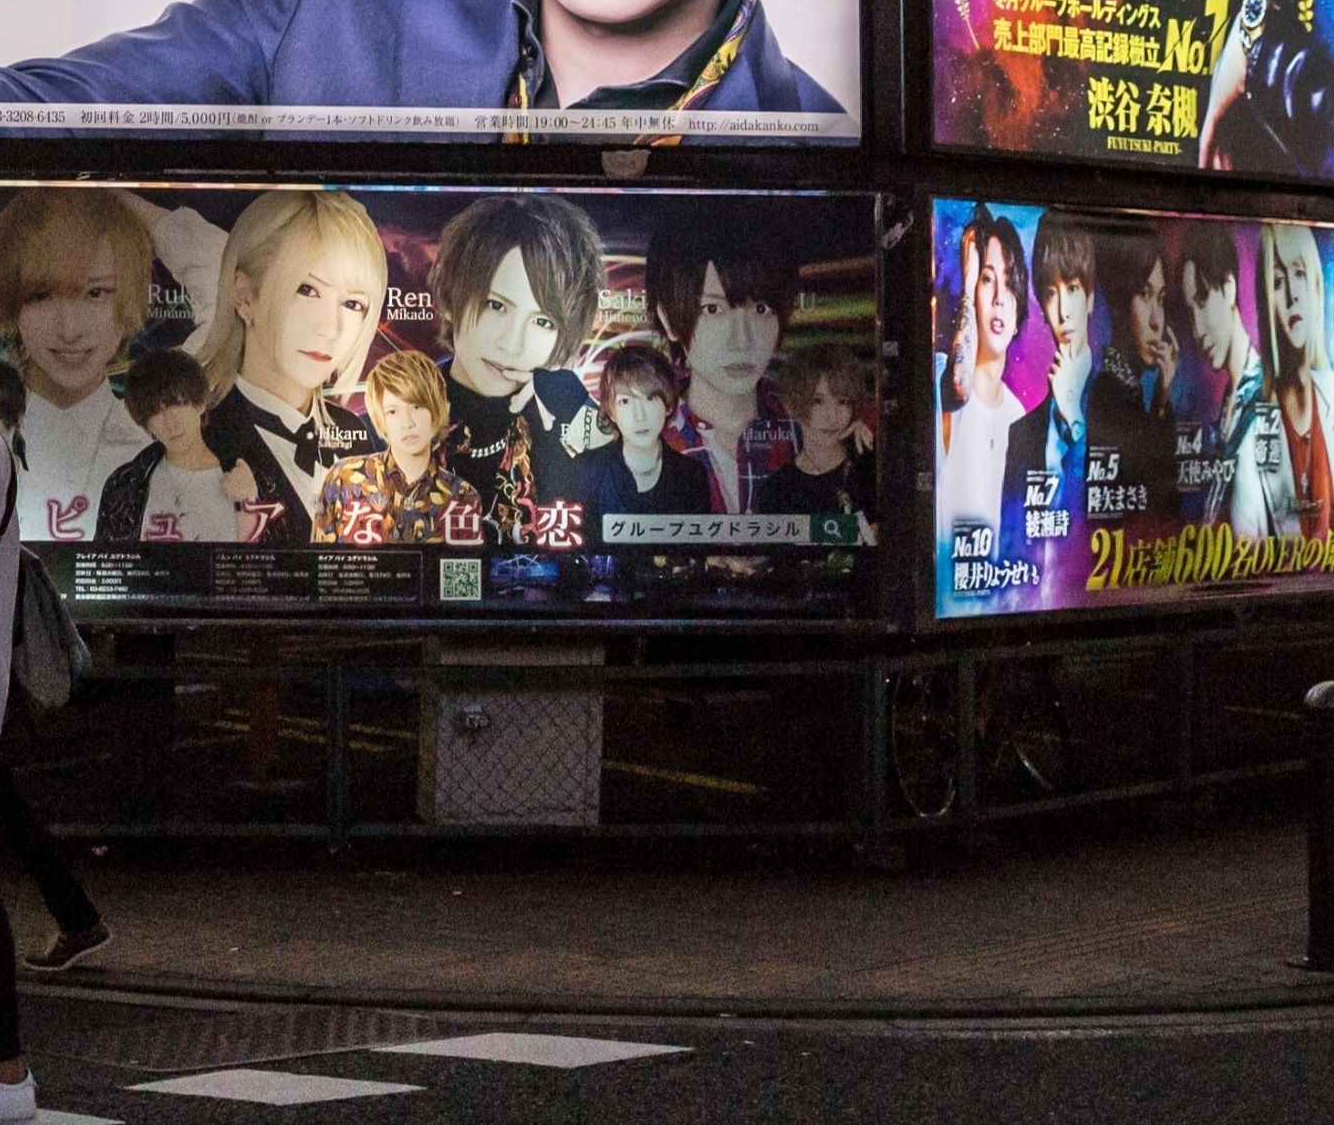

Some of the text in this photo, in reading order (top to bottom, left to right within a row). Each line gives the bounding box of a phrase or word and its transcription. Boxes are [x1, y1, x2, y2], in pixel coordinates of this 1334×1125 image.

[993, 17, 1162, 69] 売上部門最高記録樹立
[1087, 76, 1141, 133] 渋谷
[80, 111, 135, 125] 初回料金
[475, 114, 529, 130] 営業時間
[621, 115, 676, 131] 年中無休
[688, 118, 820, 135] http://aidakanko.com
[386, 287, 433, 309] Ren
[597, 288, 647, 311] Saki
[386, 307, 434, 321] Mikado
[318, 426, 368, 441] Hikaru
[1086, 452, 1120, 483] No.5
[1023, 476, 1060, 508] No.7
[610, 518, 801, 539] グループユグドラシル
[951, 526, 994, 559] No.10
